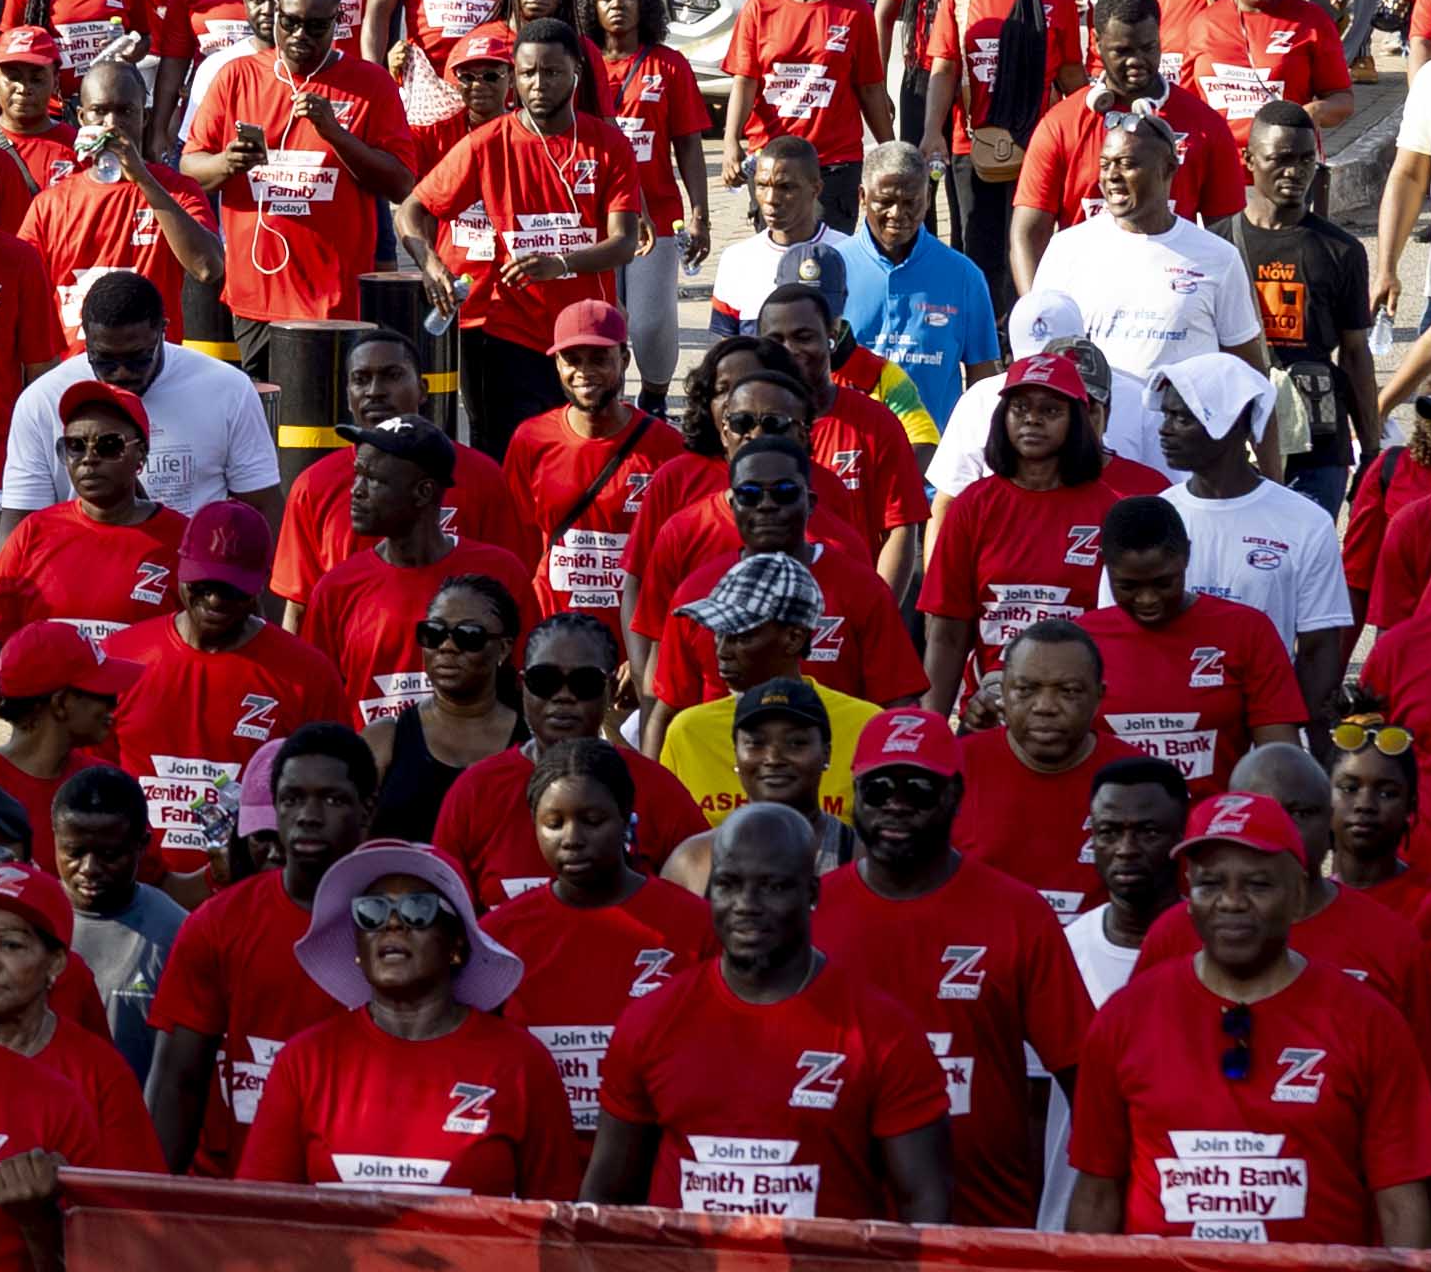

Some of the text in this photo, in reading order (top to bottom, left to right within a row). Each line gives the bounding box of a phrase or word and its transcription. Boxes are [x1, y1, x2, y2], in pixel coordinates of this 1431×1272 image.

[298, 170, 334, 184] Bank
[268, 185, 316, 199] Family
[512, 231, 594, 250] Zenith Bank
[146, 455, 180, 474] Life
[570, 532, 617, 548] Join the
[567, 571, 624, 589] Family
[573, 591, 615, 606] today!
[1004, 588, 1056, 602] Join the
[983, 607, 1032, 624] Zenith
[1123, 717, 1185, 731] Join the
[1164, 738, 1211, 756] Bank
[166, 761, 198, 776] Join
[142, 784, 197, 803] Zenith
[789, 1092, 838, 1108] ZENITH
[708, 1144, 781, 1160] Join the
[1190, 1137, 1266, 1154] Join the
[354, 1161, 429, 1179] Join the
[1163, 1167, 1303, 1190] Zenith Bank
[683, 1171, 813, 1194] Zenith Bank
[1186, 1193, 1276, 1216] Family
[1197, 1225, 1260, 1242] today!
